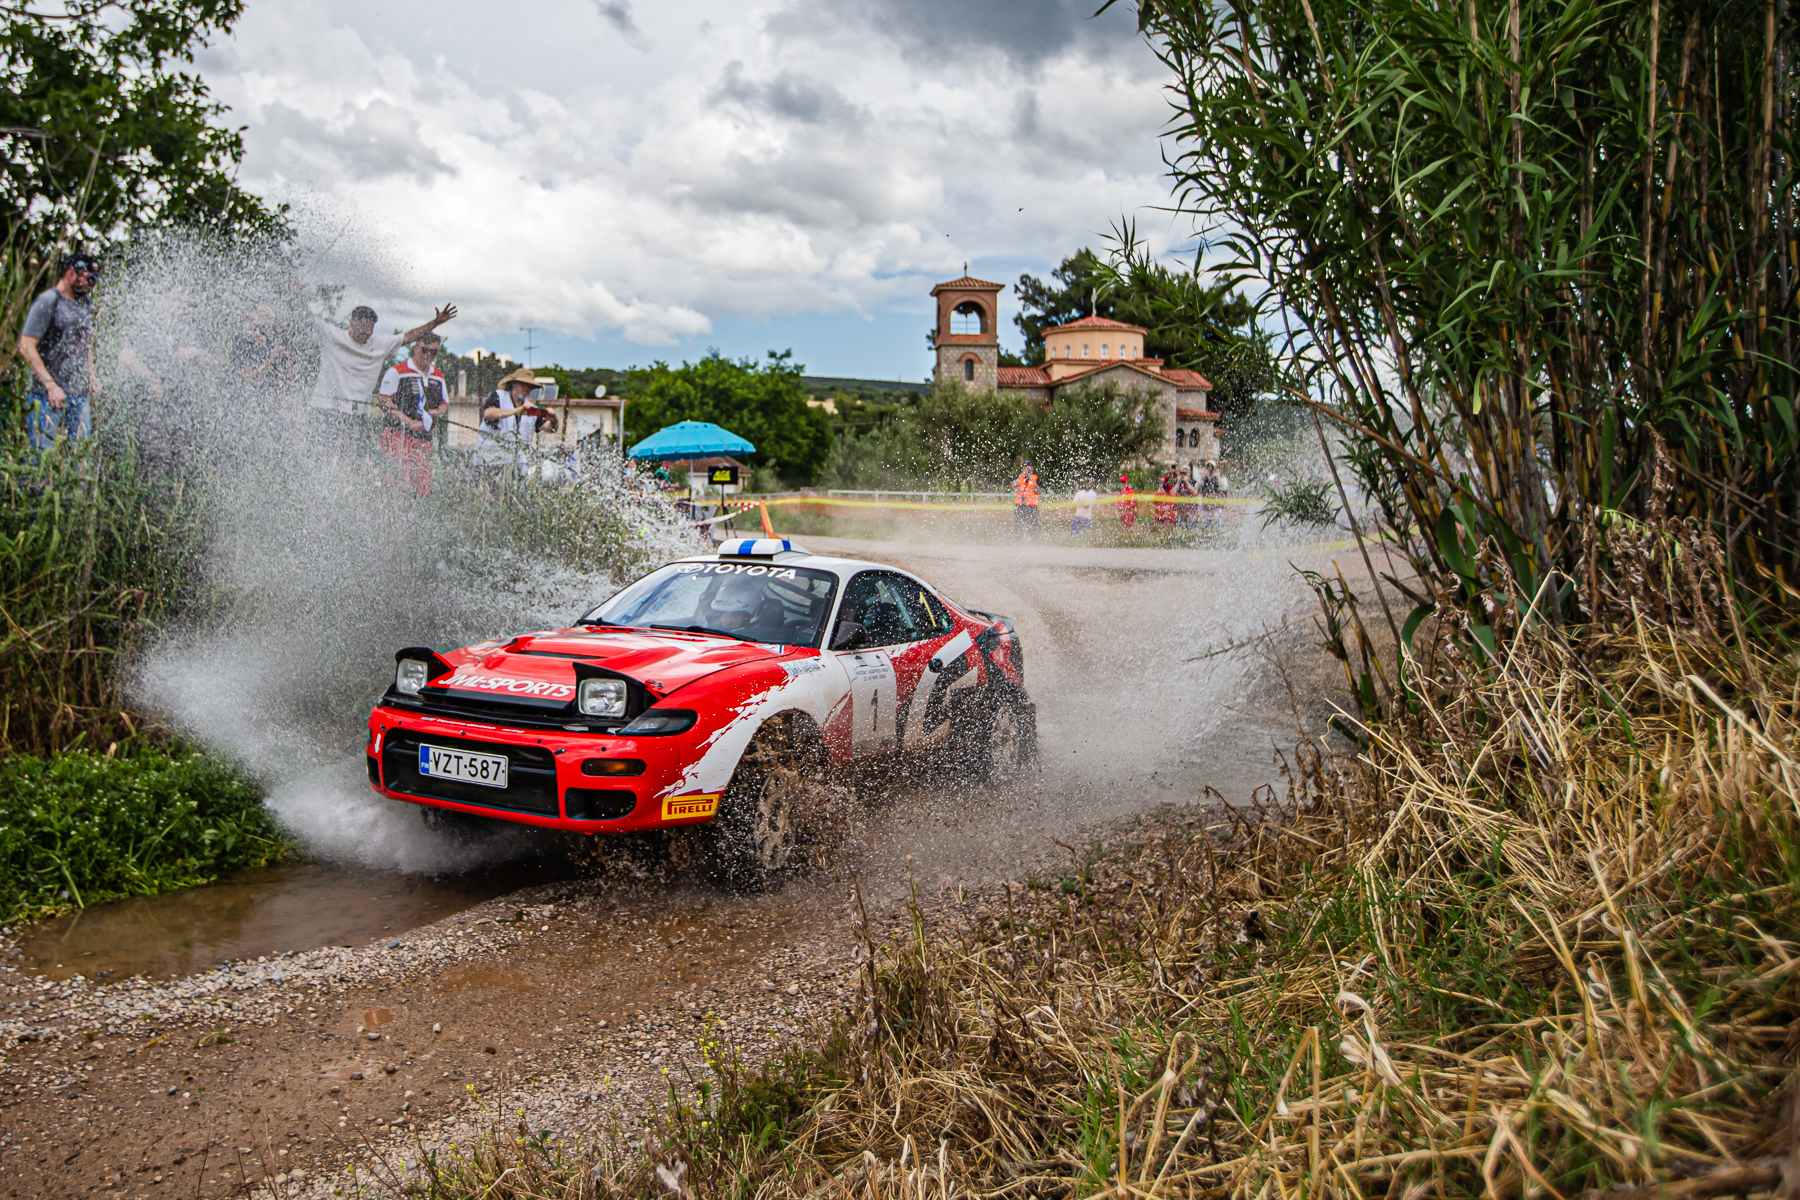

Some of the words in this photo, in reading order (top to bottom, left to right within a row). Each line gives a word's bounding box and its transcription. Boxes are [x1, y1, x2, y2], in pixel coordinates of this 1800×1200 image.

[703, 563, 796, 580] TOYOTA
[870, 688, 879, 732] 1
[433, 751, 502, 781] VZT-587
[667, 799, 714, 815] PIRELLI
